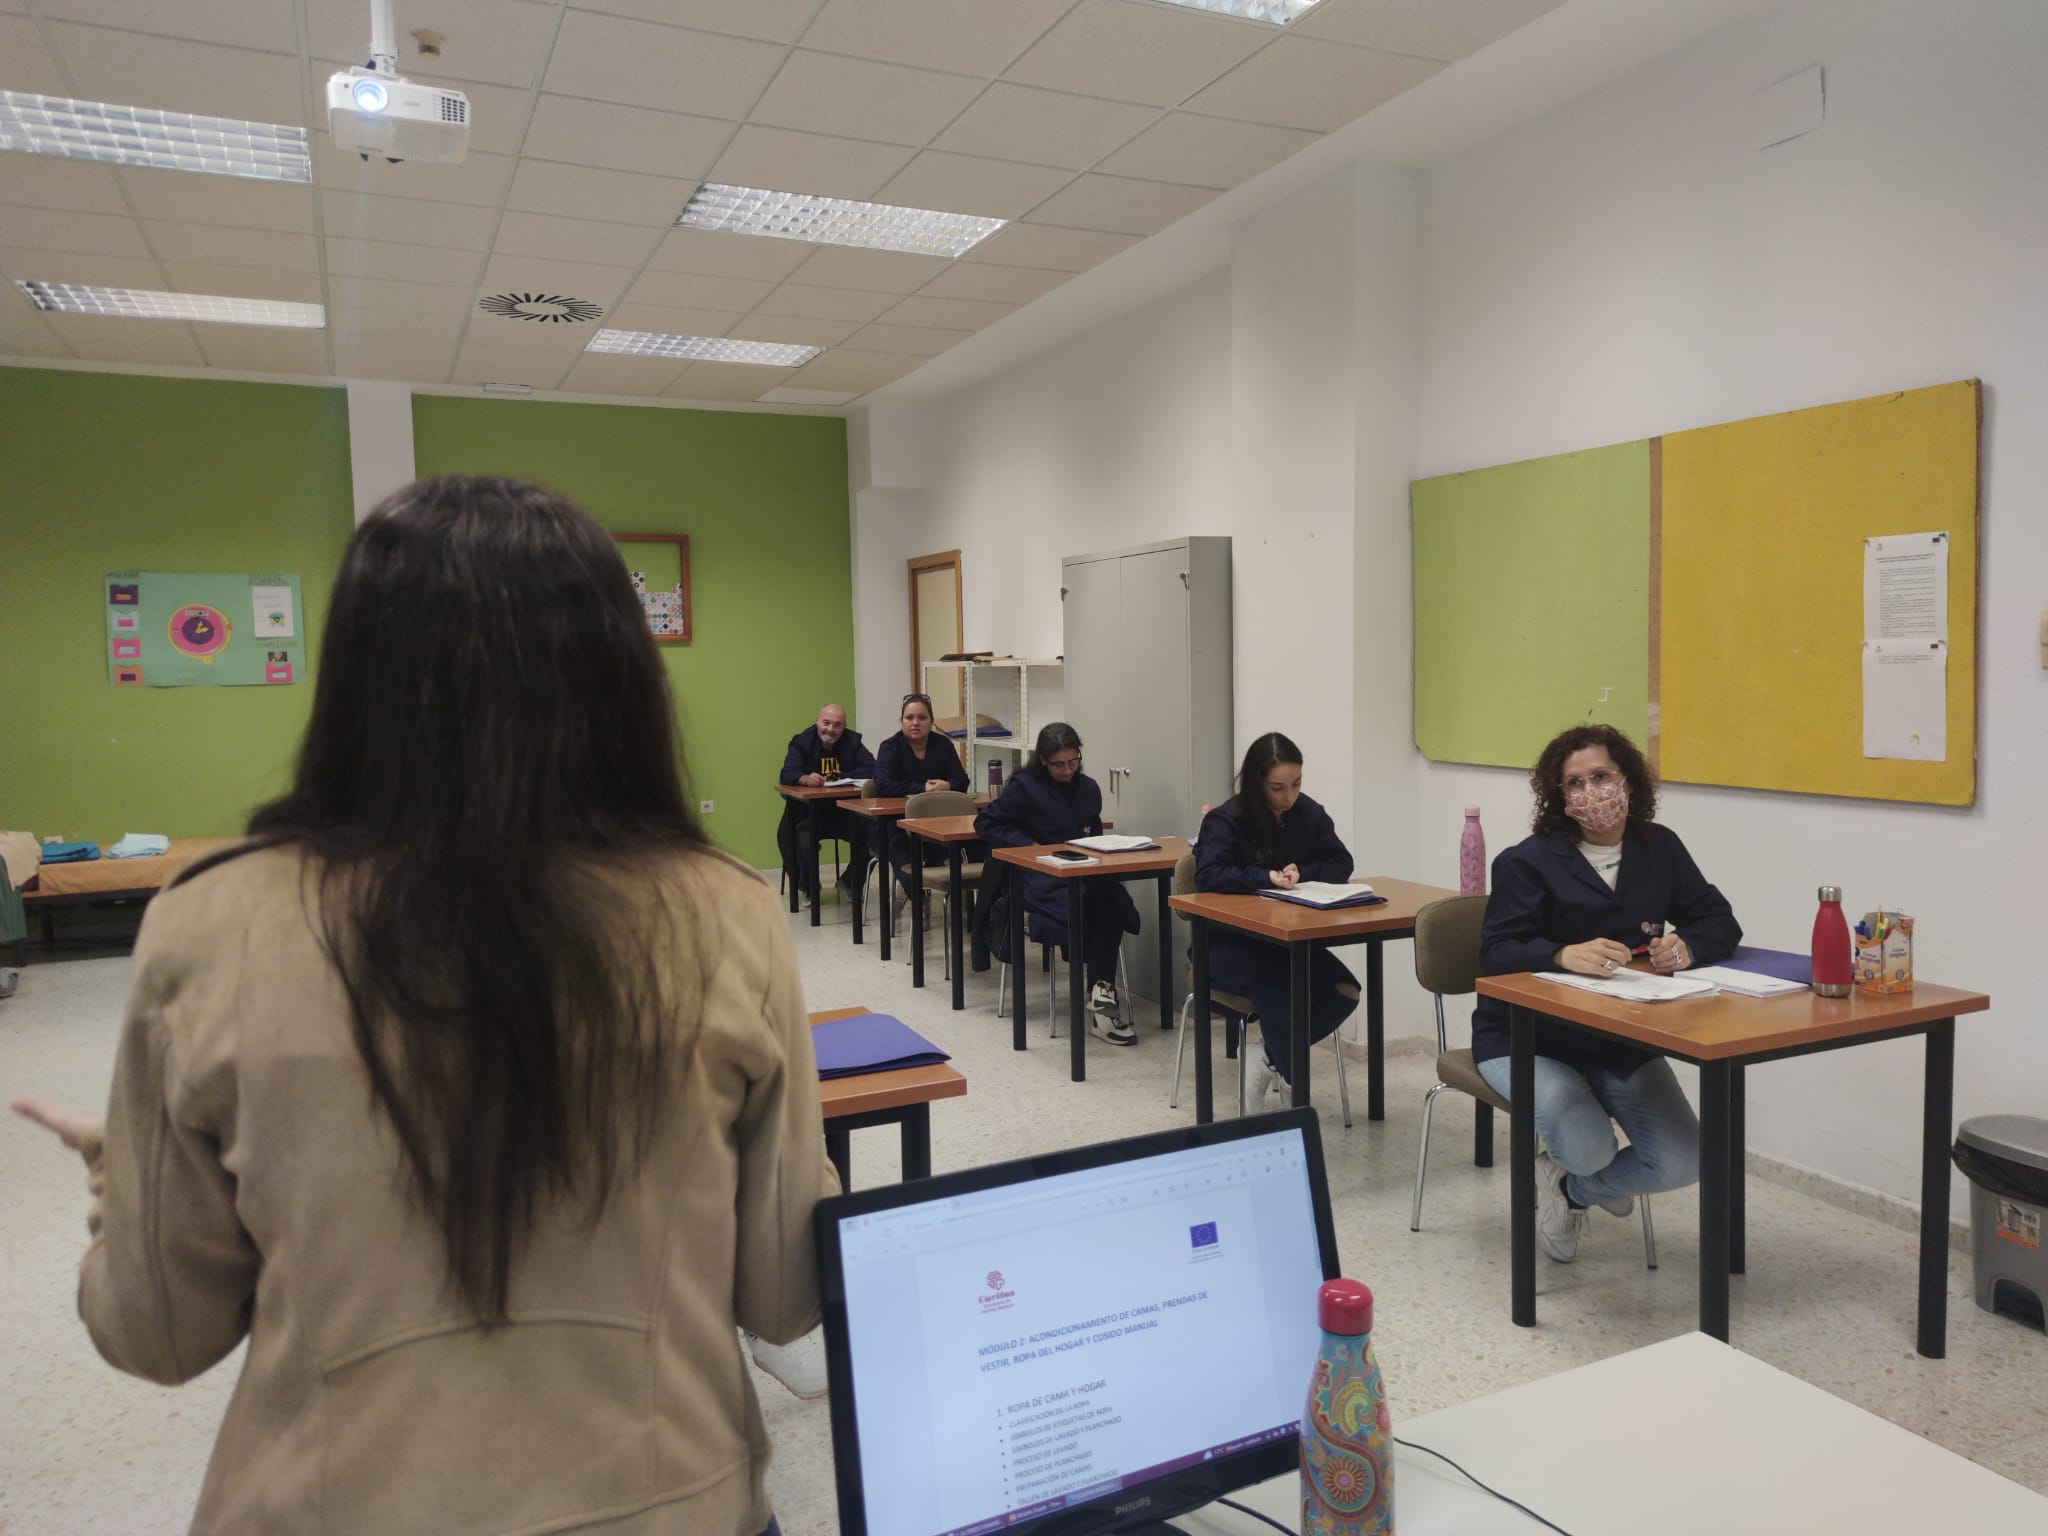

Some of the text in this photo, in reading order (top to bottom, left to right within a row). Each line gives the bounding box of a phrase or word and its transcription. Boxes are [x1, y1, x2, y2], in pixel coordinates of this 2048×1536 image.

[1019, 1337, 1028, 1347] 2:
[1029, 1313, 1118, 1344] ACONDICIONAMIENTO
[1119, 1310, 1129, 1320] DE
[1131, 1304, 1160, 1317] CAMAS,
[1162, 1294, 1197, 1309] PRENDAS
[1198, 1290, 1209, 1300] DE
[980, 1319, 1158, 1372] VESTIR, ROPA DEL HOGAR Y COSIDO MANUAL
[1007, 1401, 1030, 1414] ROPA
[1032, 1396, 1043, 1407] DE
[1045, 1390, 1070, 1403] CAMA
[1071, 1387, 1077, 1395] Y
[1078, 1379, 1106, 1394] HOGAR
[1055, 1407, 1063, 1415] DE
[1074, 1399, 1090, 1409] ROPA
[1043, 1422, 1051, 1431] DE
[1086, 1410, 1095, 1419] DE
[1096, 1406, 1113, 1415] ROPA
[1045, 1435, 1053, 1444] DE
[1054, 1427, 1080, 1441] LAVADO
[1085, 1415, 1122, 1432] PLANCHADO
[1013, 1441, 1078, 1466] PROCESO DE LAVADO
[1014, 1450, 1092, 1480] PROCESO DE PLANCHADO
[1041, 1489, 1050, 1499] DE
[1051, 1482, 1076, 1496] LAVADO
[1081, 1468, 1119, 1486] PLANCHADO
[1061, 1469, 1070, 1479] DE
[1114, 1496, 1151, 1516] PHILIPS
